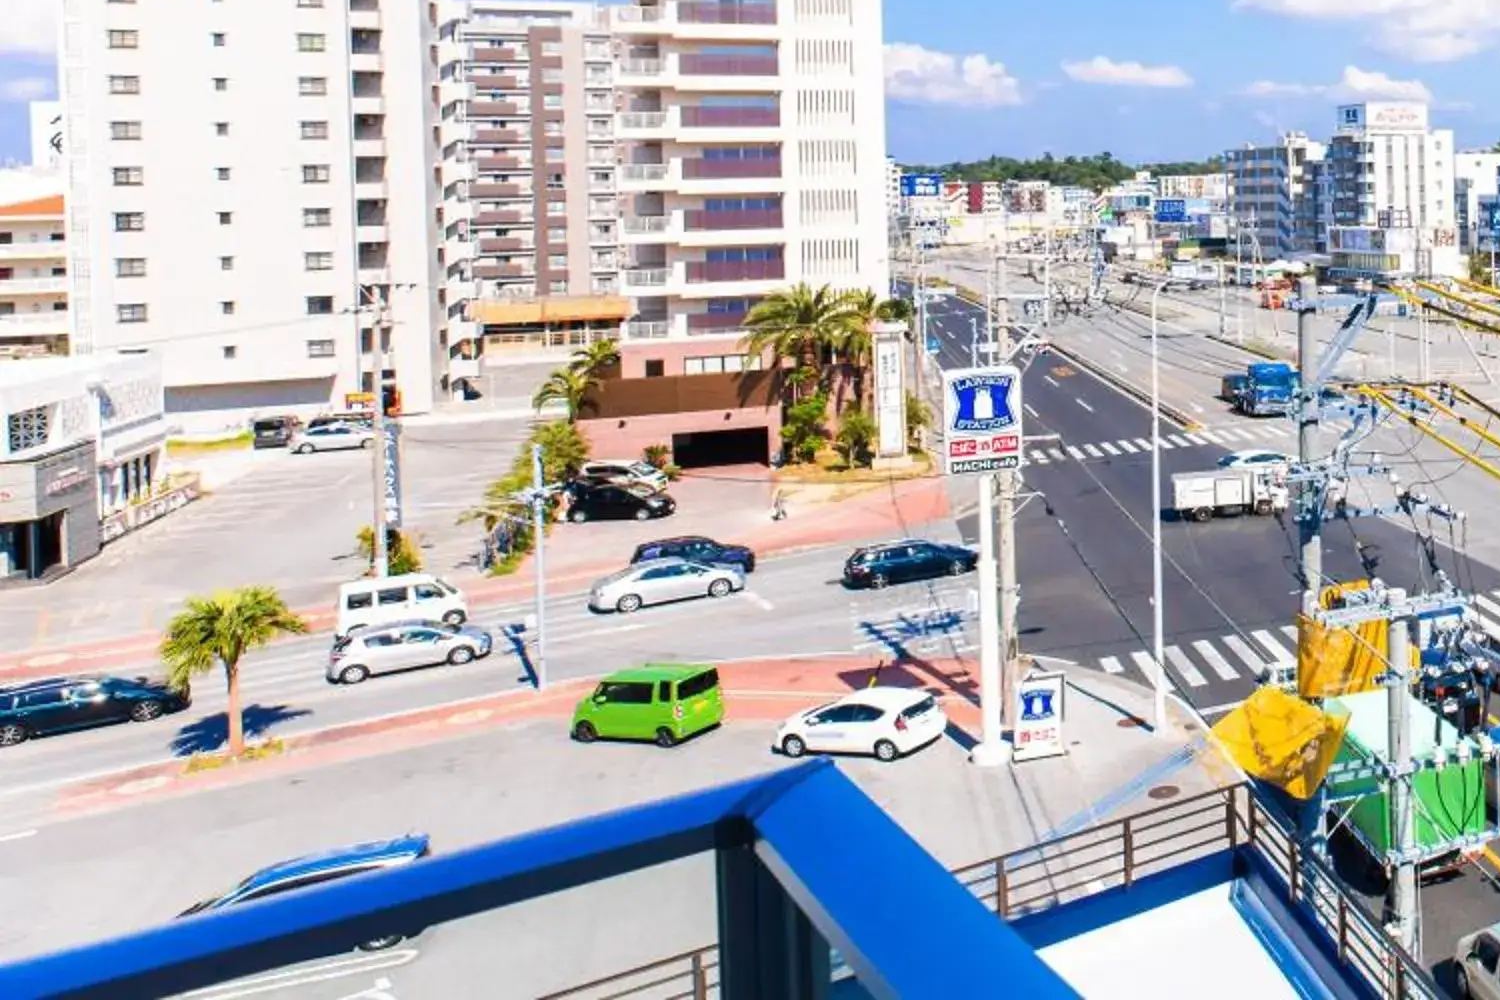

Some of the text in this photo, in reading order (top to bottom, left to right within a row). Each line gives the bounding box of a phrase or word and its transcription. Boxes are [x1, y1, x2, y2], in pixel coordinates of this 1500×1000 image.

[956, 376, 1010, 391] LAWSON
[957, 415, 1010, 430] STATION
[993, 437, 1017, 450] ATM
[953, 459, 991, 473] MACHI
